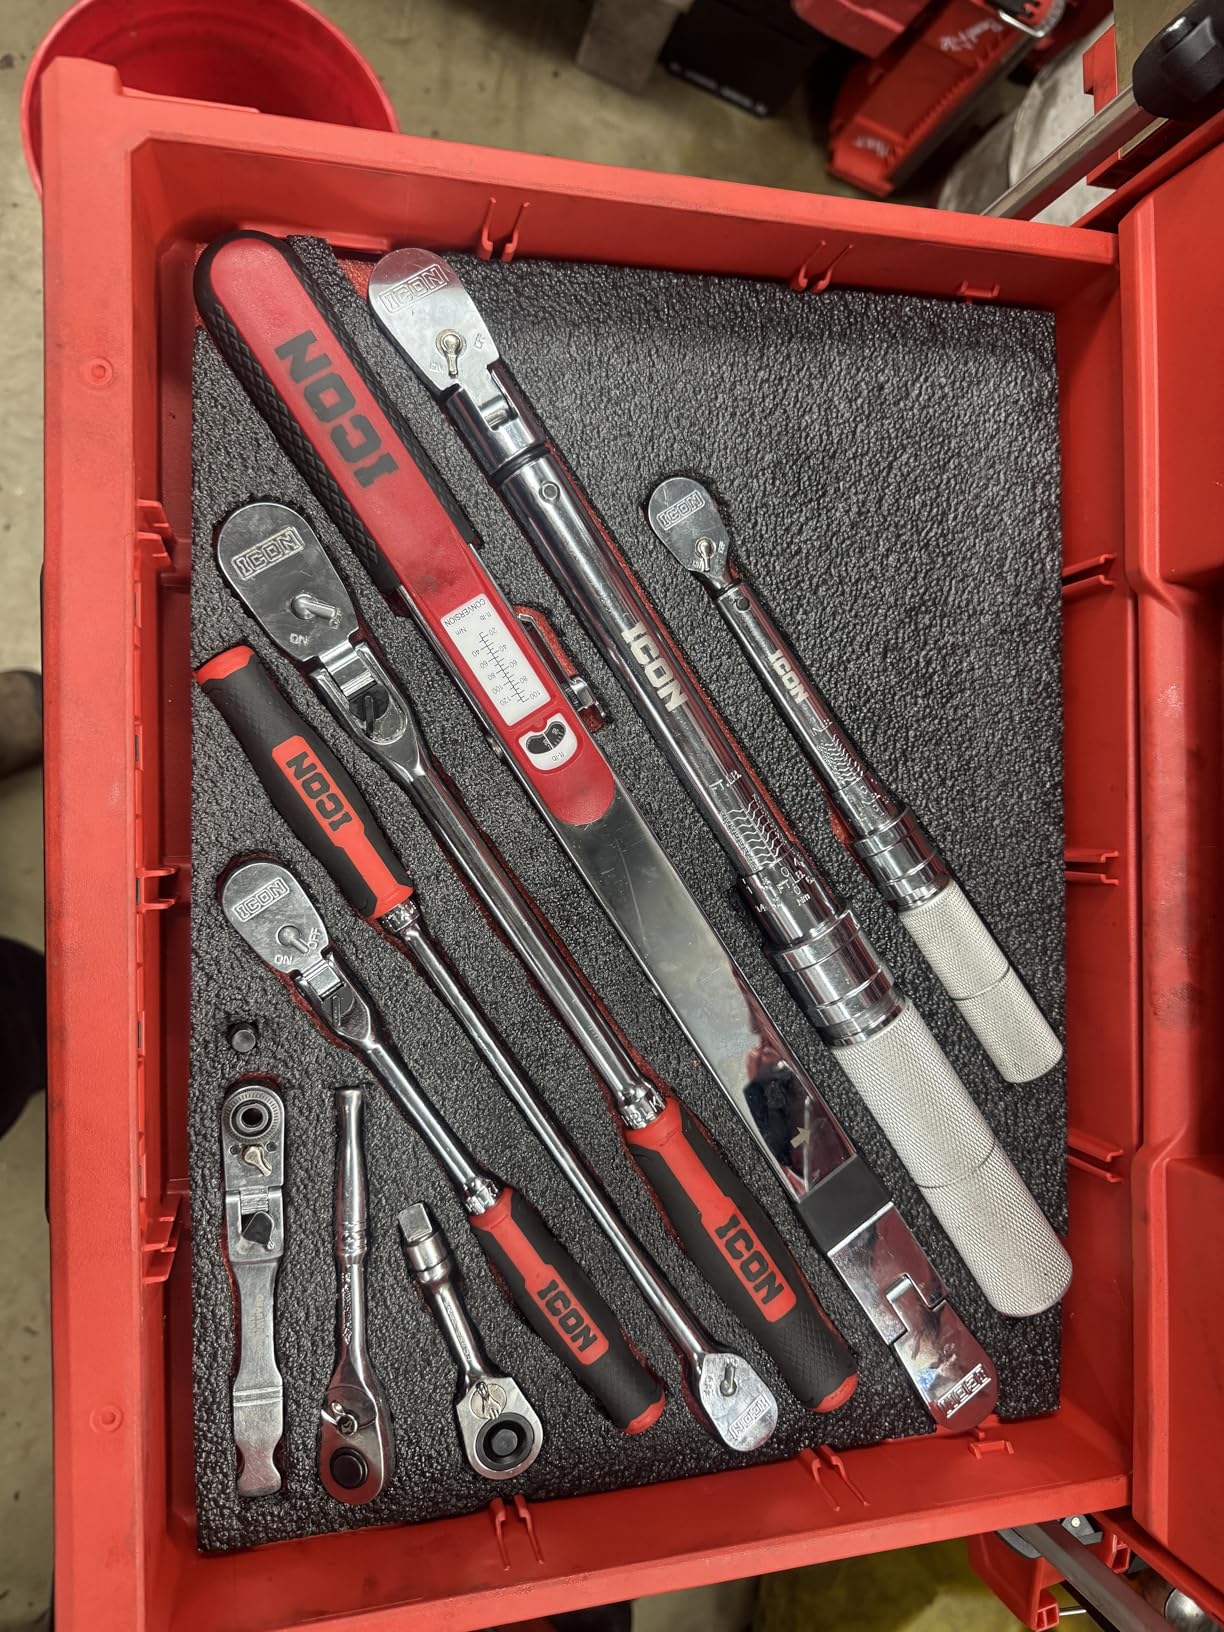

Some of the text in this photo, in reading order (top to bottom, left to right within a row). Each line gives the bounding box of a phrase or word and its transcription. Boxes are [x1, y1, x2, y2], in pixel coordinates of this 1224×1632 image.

[381, 264, 446, 312] ICON
[274, 330, 399, 488] ICON
[657, 491, 704, 528] ICON
[233, 528, 301, 578] ICON
[443, 598, 486, 627] CONVERSION
[487, 627, 497, 636] 20
[471, 647, 481, 657] 40
[498, 642, 508, 652] 40
[621, 622, 688, 712] ICON
[491, 684, 504, 695] 100
[529, 689, 541, 700] 100
[768, 649, 809, 704] ICON
[499, 695, 511, 706] 120
[285, 752, 353, 832] ICON
[234, 877, 288, 920] ICON
[307, 927, 320, 949] OFF
[274, 955, 294, 964] ON
[715, 1214, 784, 1305] ICON
[537, 1279, 598, 1352] ICON
[936, 1366, 990, 1416] ICON
[727, 1396, 770, 1438] ICON
